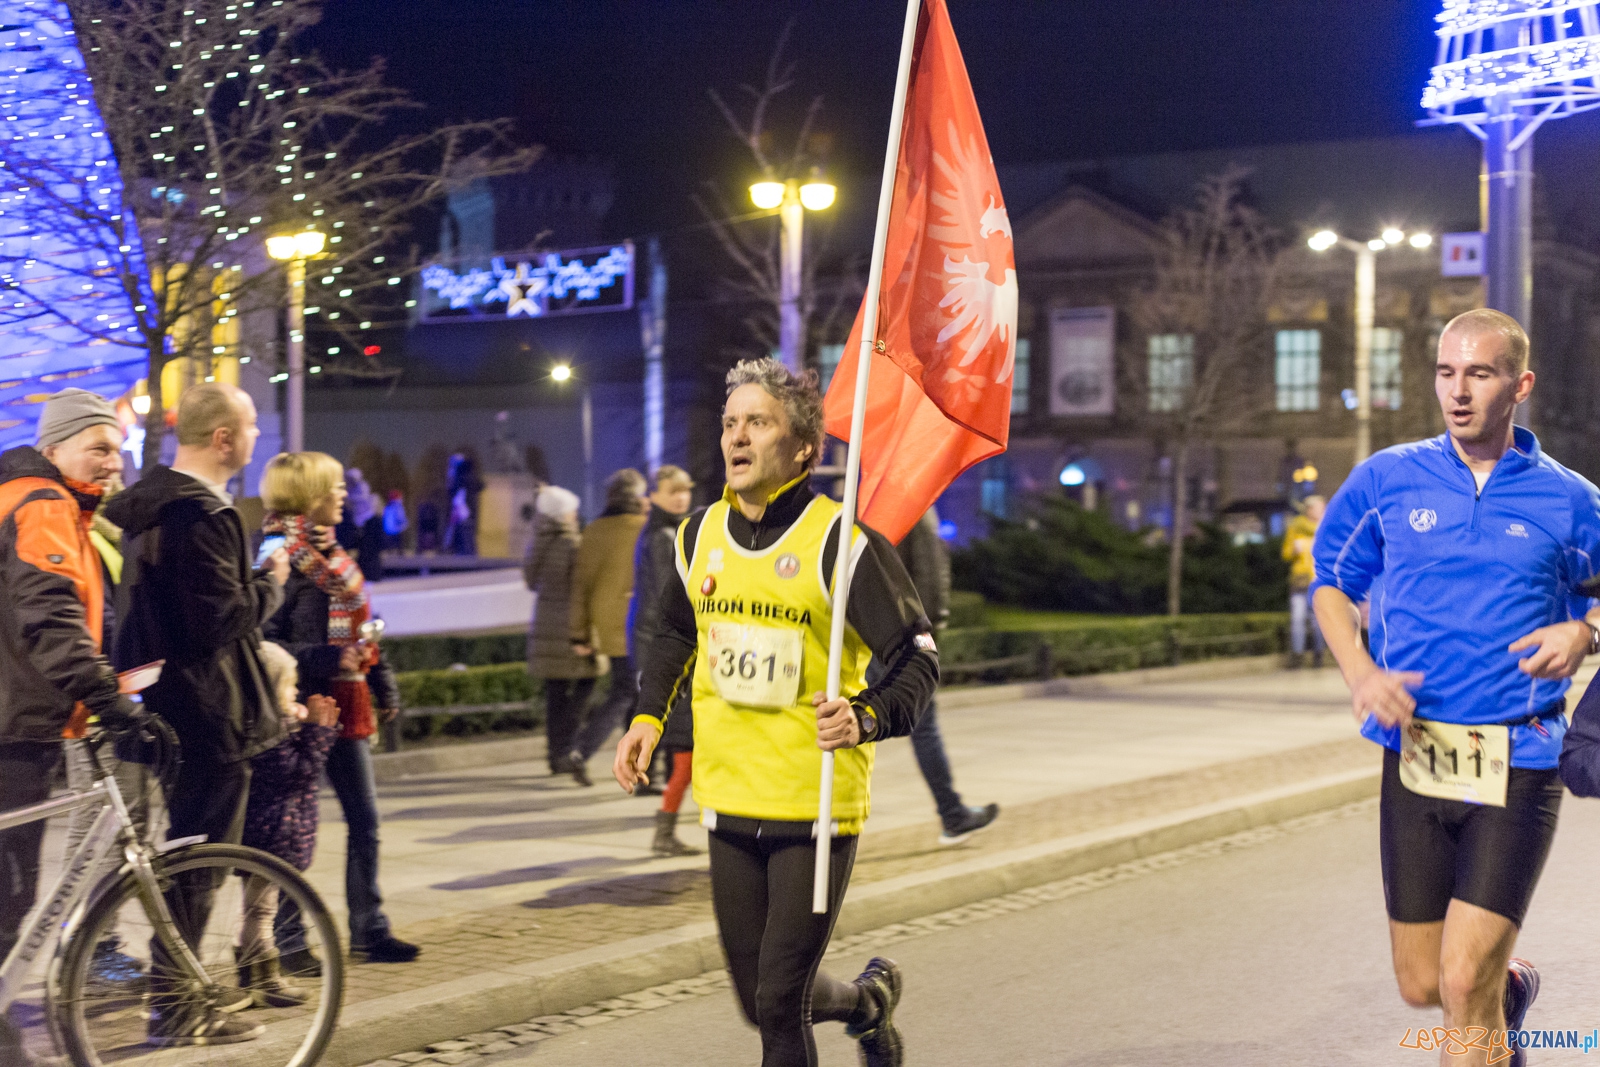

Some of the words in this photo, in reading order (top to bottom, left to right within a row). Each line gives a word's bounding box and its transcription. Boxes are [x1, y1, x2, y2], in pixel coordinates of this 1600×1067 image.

[751, 601, 812, 626] BIEGA
[720, 648, 777, 683] 361
[1421, 743, 1482, 778] 111
